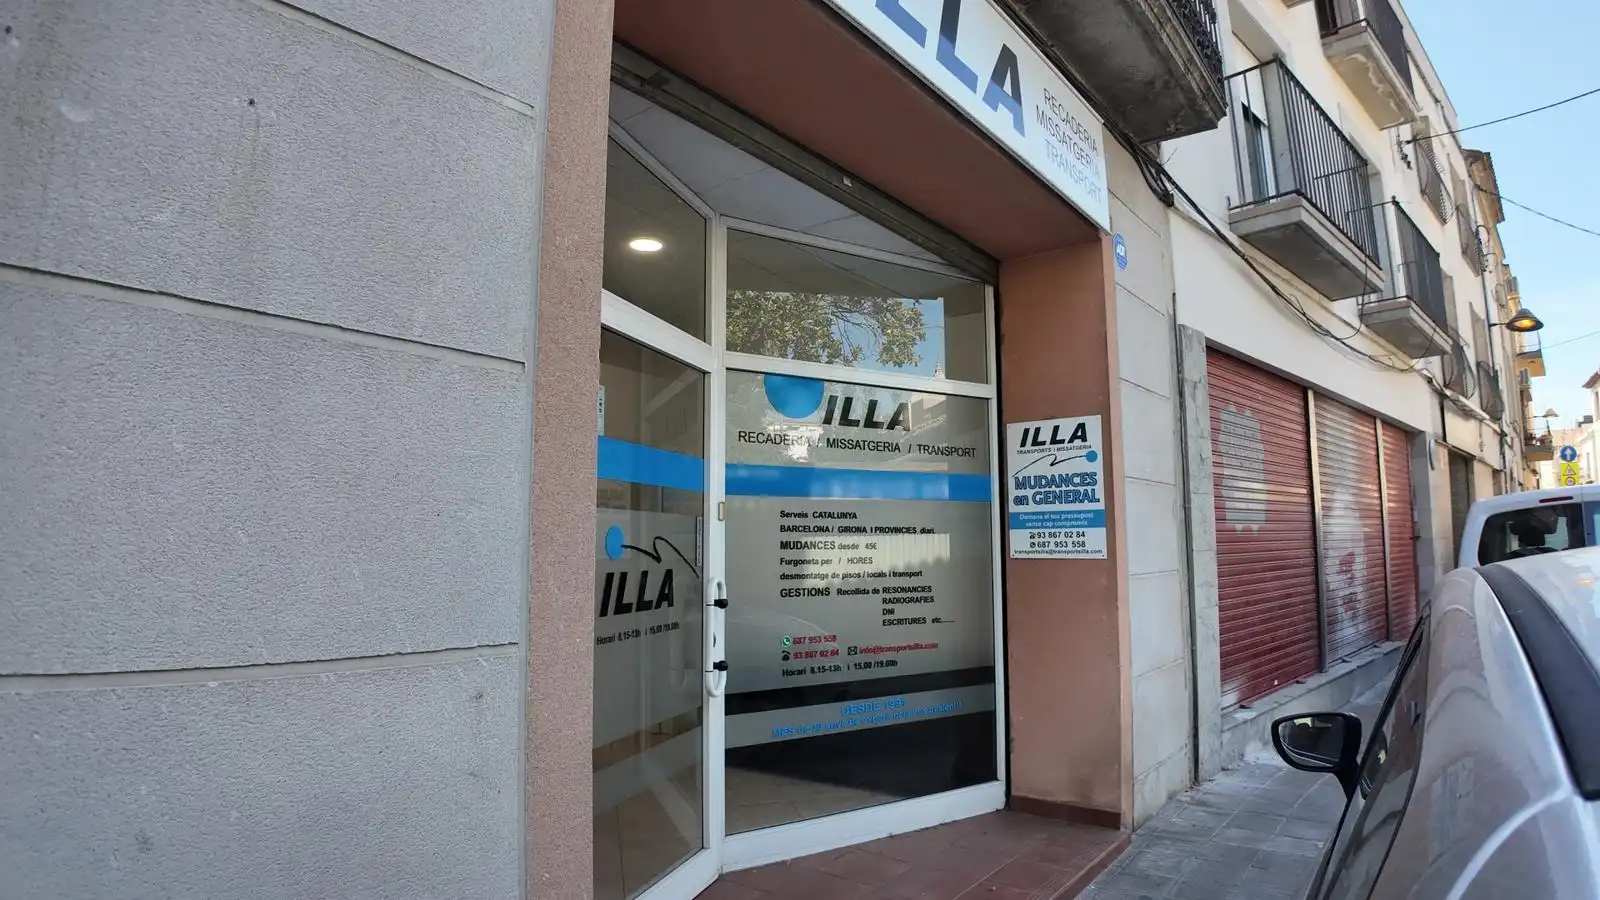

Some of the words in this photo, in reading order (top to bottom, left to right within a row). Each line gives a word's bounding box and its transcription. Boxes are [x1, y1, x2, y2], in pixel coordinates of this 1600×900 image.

[1043, 88, 1098, 154] RECADERIA
[1035, 104, 1100, 178] MISSATGERIA
[1044, 138, 1102, 204] TRANSPORT
[822, 395, 912, 431] ILLA
[1019, 421, 1088, 447] ILLA
[738, 429, 811, 447] RECADERIA
[826, 437, 901, 453] MISSATGERIA
[917, 444, 977, 459] TRANSPORT
[1017, 447, 1052, 455] TRANSPORTS
[1056, 444, 1092, 452] MISSATGERIA
[1014, 472, 1098, 490] MUDANCES
[1013, 493, 1030, 506] en
[1031, 487, 1101, 505] GENERAL
[779, 510, 809, 519] Serveis
[812, 511, 858, 520] CATALUNYA
[838, 526, 867, 534] GIRONA
[874, 526, 917, 534] PROVINCIES
[1048, 531, 1061, 539] 867
[1076, 530, 1086, 538] 84
[780, 541, 836, 551] MUDANCES
[837, 542, 860, 550] desde
[864, 542, 878, 550] 45€
[1036, 541, 1050, 549] 687
[1071, 540, 1086, 548] 558
[780, 557, 819, 567] Furgoneta
[820, 558, 833, 567] per
[847, 556, 873, 565] HORES
[779, 572, 830, 581] desmontatge
[830, 572, 840, 580] de
[841, 571, 861, 580] pisos
[866, 570, 887, 579] locals
[892, 570, 923, 579] transport
[599, 568, 674, 618] ILLA
[780, 587, 831, 598] GESTIONS
[836, 587, 870, 596] Recollida
[871, 587, 880, 595] de
[882, 585, 933, 594] RESONANCIES
[882, 595, 935, 605] RADIOGRAFIES
[882, 607, 895, 616] DNI
[882, 617, 927, 627] ESCRITURES
[597, 632, 616, 646] Horari
[792, 636, 807, 645] 687
[808, 635, 822, 644] 953
[823, 634, 837, 643] 558
[792, 651, 803, 660] 93
[804, 650, 818, 659] 867
[819, 649, 829, 658] 02
[829, 648, 840, 657] 84
[782, 667, 807, 678] Horari
[810, 664, 842, 675] 8.15-13h
[853, 661, 872, 670] 15.00
[841, 700, 880, 716] DESDE
